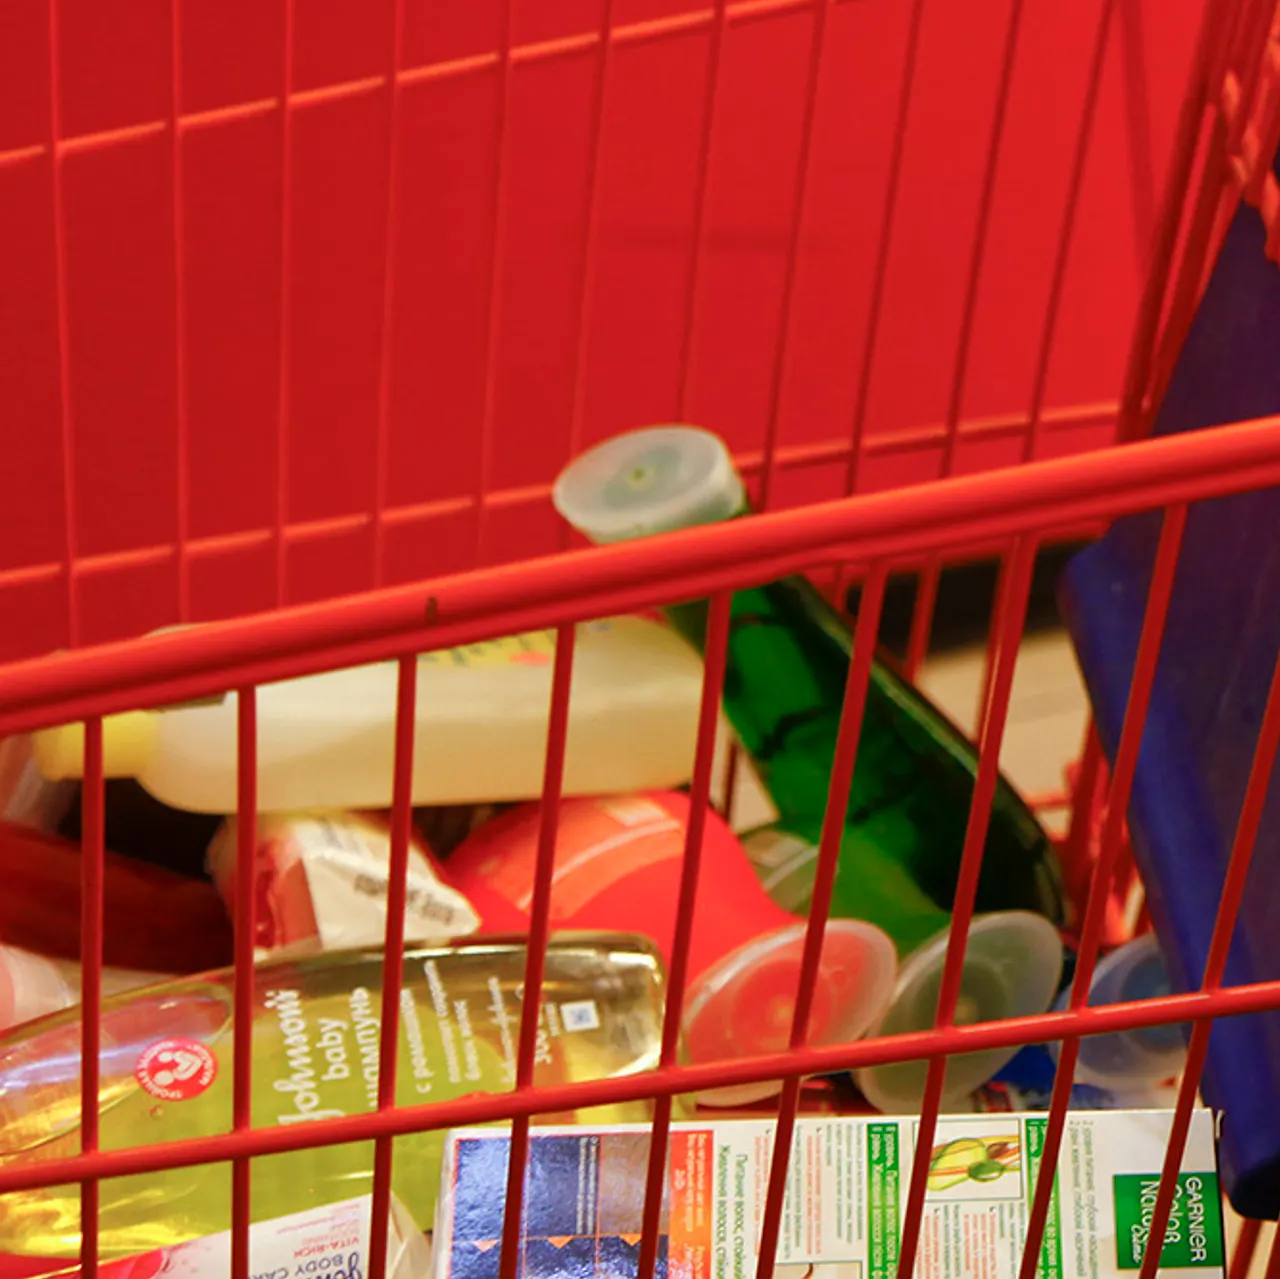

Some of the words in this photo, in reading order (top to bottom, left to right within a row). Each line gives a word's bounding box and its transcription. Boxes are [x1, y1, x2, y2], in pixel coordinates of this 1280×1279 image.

[317, 1017, 349, 1081] baby
[1185, 1177, 1206, 1262] GARNIER
[296, 1252, 344, 1275] BODY
